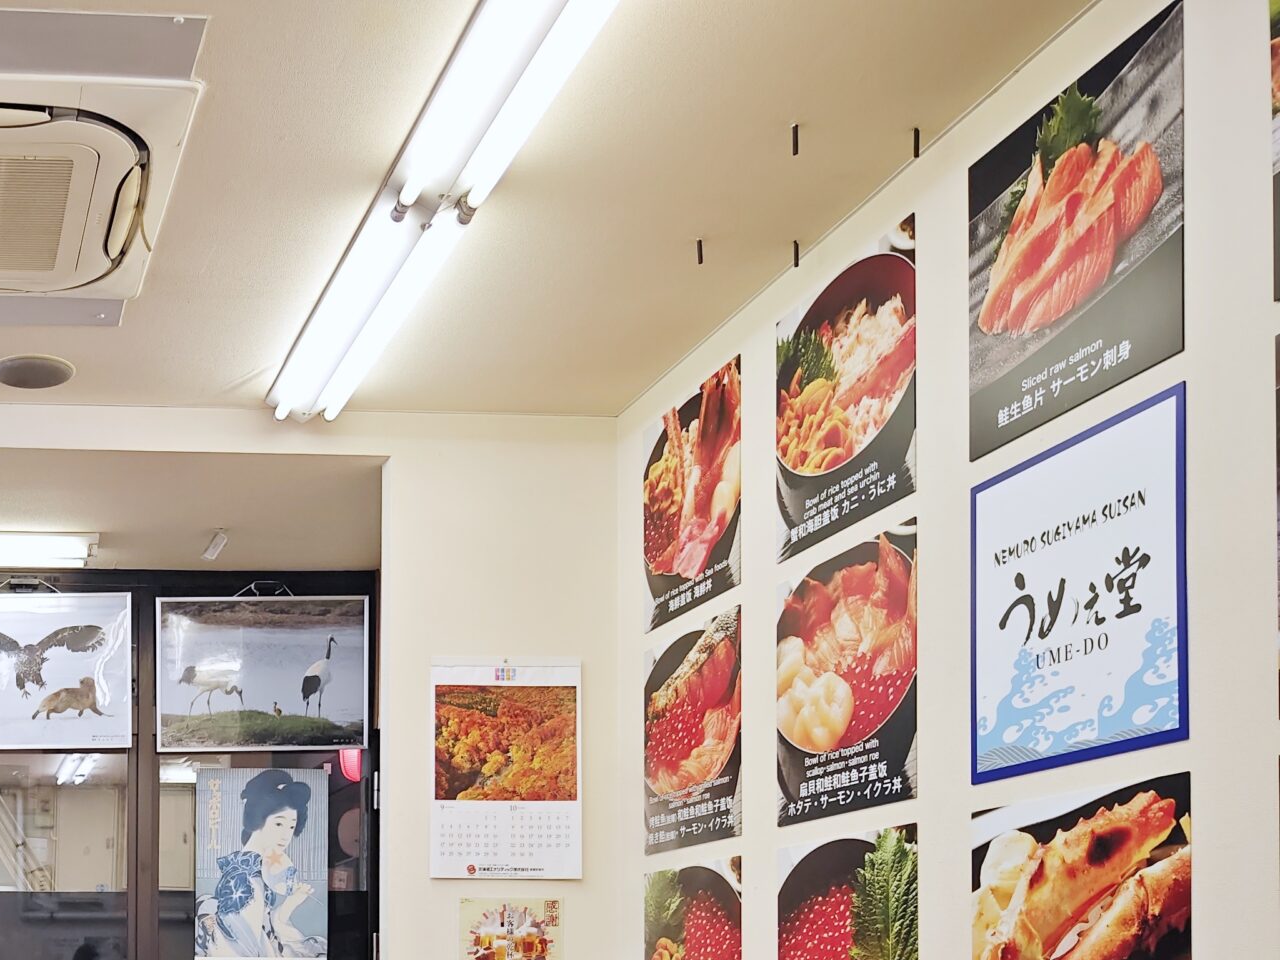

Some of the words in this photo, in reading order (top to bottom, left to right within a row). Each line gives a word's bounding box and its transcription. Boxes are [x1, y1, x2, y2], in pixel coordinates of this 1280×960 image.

[1022, 368, 1048, 392] Sliced
[1049, 360, 1067, 377] raw
[1068, 339, 1103, 365] salmon
[1050, 339, 1131, 397] サーモン刺身
[803, 506, 817, 520] crab
[818, 500, 833, 513] meat
[834, 490, 846, 503] and
[847, 485, 858, 496] sea
[859, 471, 881, 488] urchin
[805, 494, 820, 509] Bowl
[827, 484, 840, 497] rice
[840, 468, 863, 489] topped
[864, 461, 879, 475] with
[994, 536, 1037, 567] NEMURO
[1040, 510, 1098, 546] SUGIYAMA
[1102, 488, 1147, 523] SUISAN
[1035, 632, 1109, 670] UME-DO
[804, 756, 819, 767] Bowl
[827, 750, 840, 760] rice
[840, 742, 864, 758] topped
[865, 738, 879, 749] with
[868, 751, 879, 761] roe
